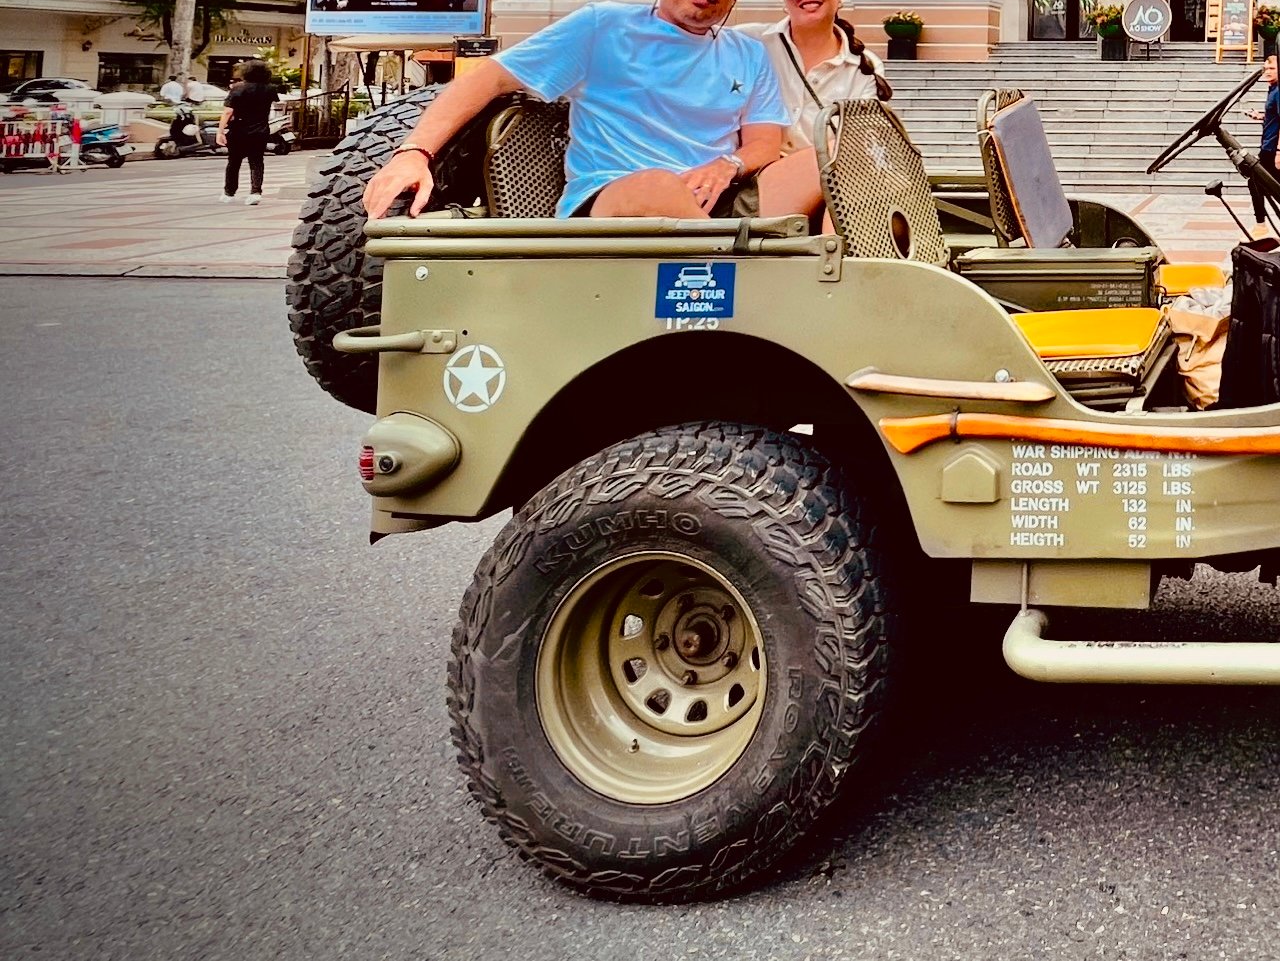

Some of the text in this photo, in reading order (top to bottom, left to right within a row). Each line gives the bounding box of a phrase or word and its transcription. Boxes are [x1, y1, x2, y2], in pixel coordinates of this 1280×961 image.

[665, 289, 725, 300] JEEP TOUR
[676, 302, 714, 312] SAIGON
[1012, 445, 1045, 459] WAR
[1050, 446, 1120, 459] SHIPPING
[1011, 463, 1053, 476] ROAD
[1076, 463, 1100, 477] WT
[1112, 464, 1147, 477] 2315
[1011, 480, 1063, 494] GROSS
[1076, 481, 1100, 494] WT
[1113, 481, 1147, 495] 3125
[1011, 498, 1069, 511] LENGTH
[1122, 499, 1147, 513] 132
[1011, 516, 1058, 529] WIDTH
[1128, 517, 1146, 530] 62
[534, 509, 703, 575] KUMHO
[1010, 533, 1064, 546] HEIGTH
[1128, 534, 1146, 548] 52
